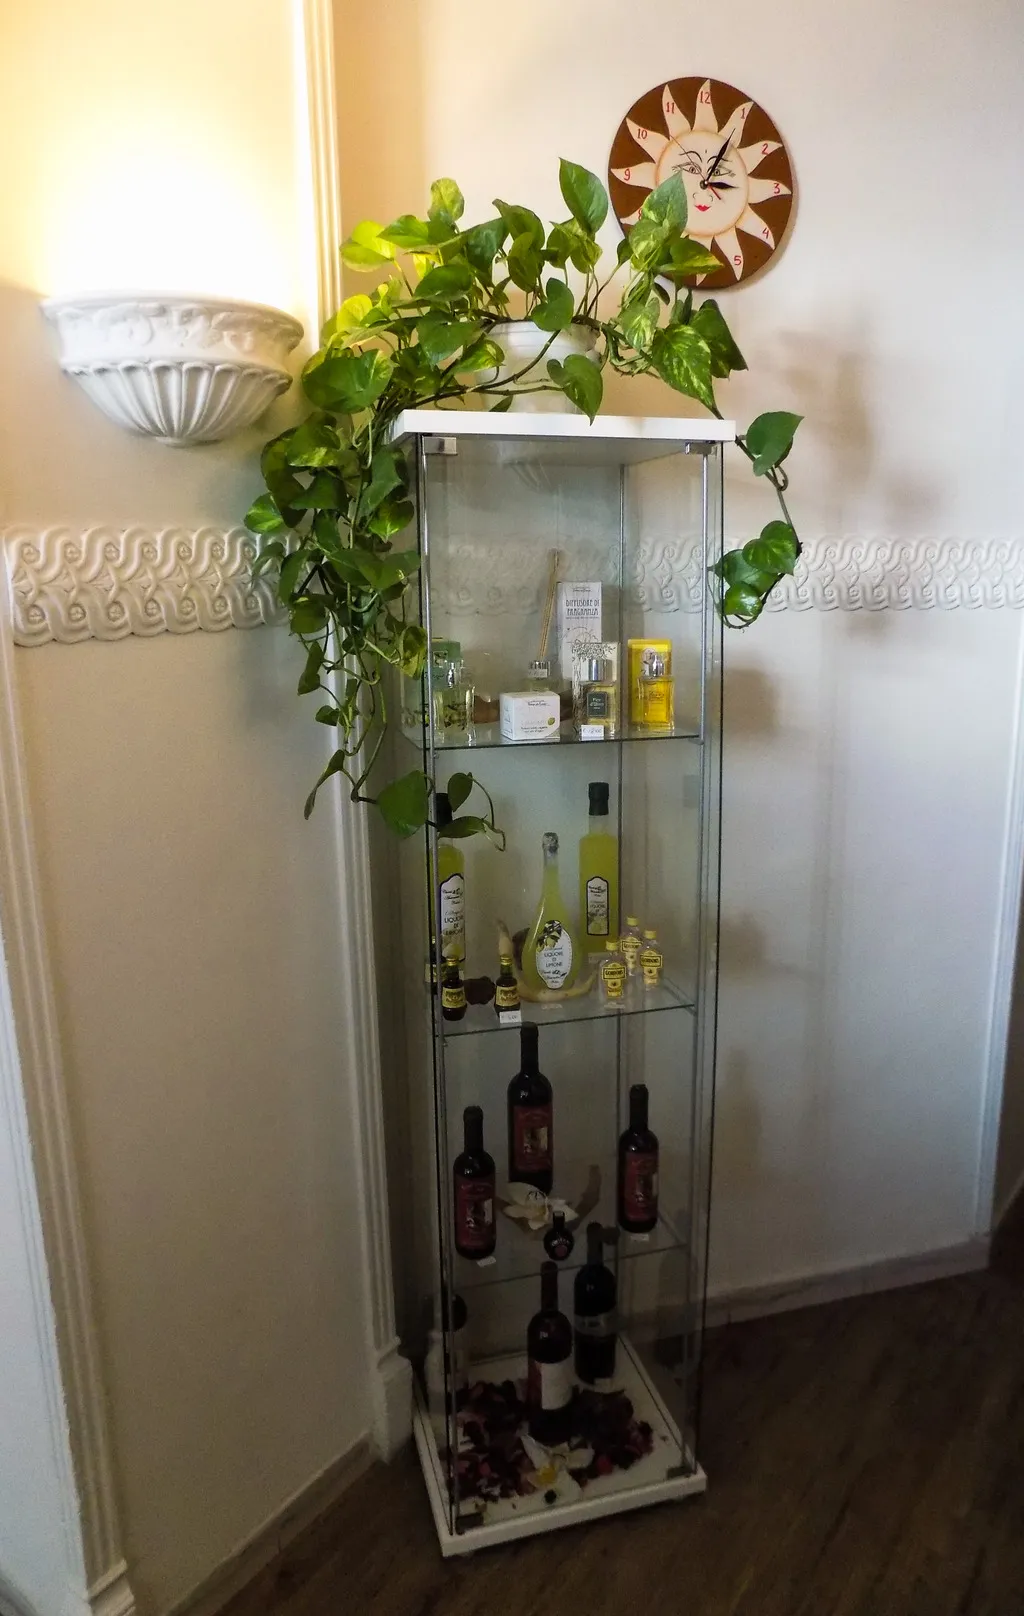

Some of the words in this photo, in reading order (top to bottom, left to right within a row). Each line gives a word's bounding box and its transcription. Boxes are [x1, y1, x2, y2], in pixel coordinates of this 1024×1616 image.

[699, 91, 711, 105] 12
[665, 101, 676, 115] 11
[740, 107, 747, 120] 1
[636, 128, 649, 140] 10
[760, 143, 770, 156] 2
[623, 168, 632, 182] 9
[773, 182, 781, 195] 3
[762, 227, 771, 239] 4
[733, 254, 742, 267] 5
[565, 599, 593, 607] DIFFUSORE
[593, 599, 600, 607] DI
